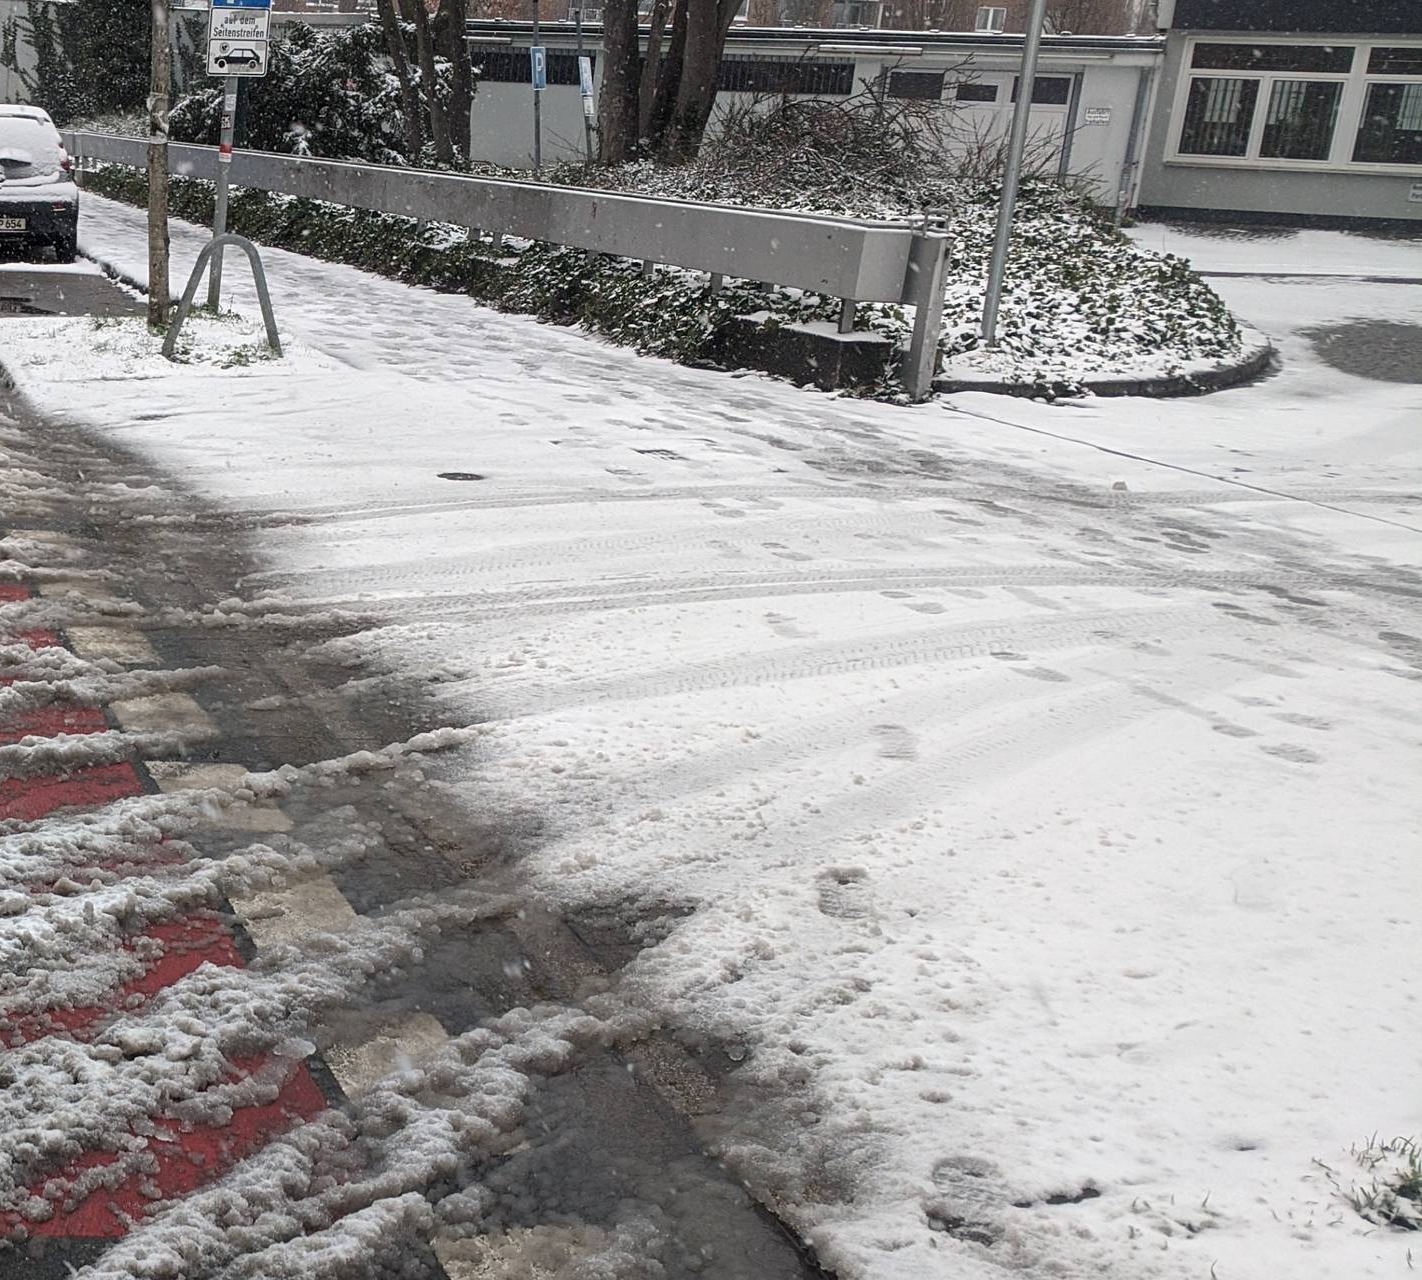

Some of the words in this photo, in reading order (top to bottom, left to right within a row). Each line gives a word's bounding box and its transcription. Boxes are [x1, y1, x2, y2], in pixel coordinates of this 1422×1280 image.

[224, 15, 237, 24] auf
[239, 16, 256, 24] dem
[213, 27, 265, 38] Seitenstreifen
[5, 219, 22, 229] 654
